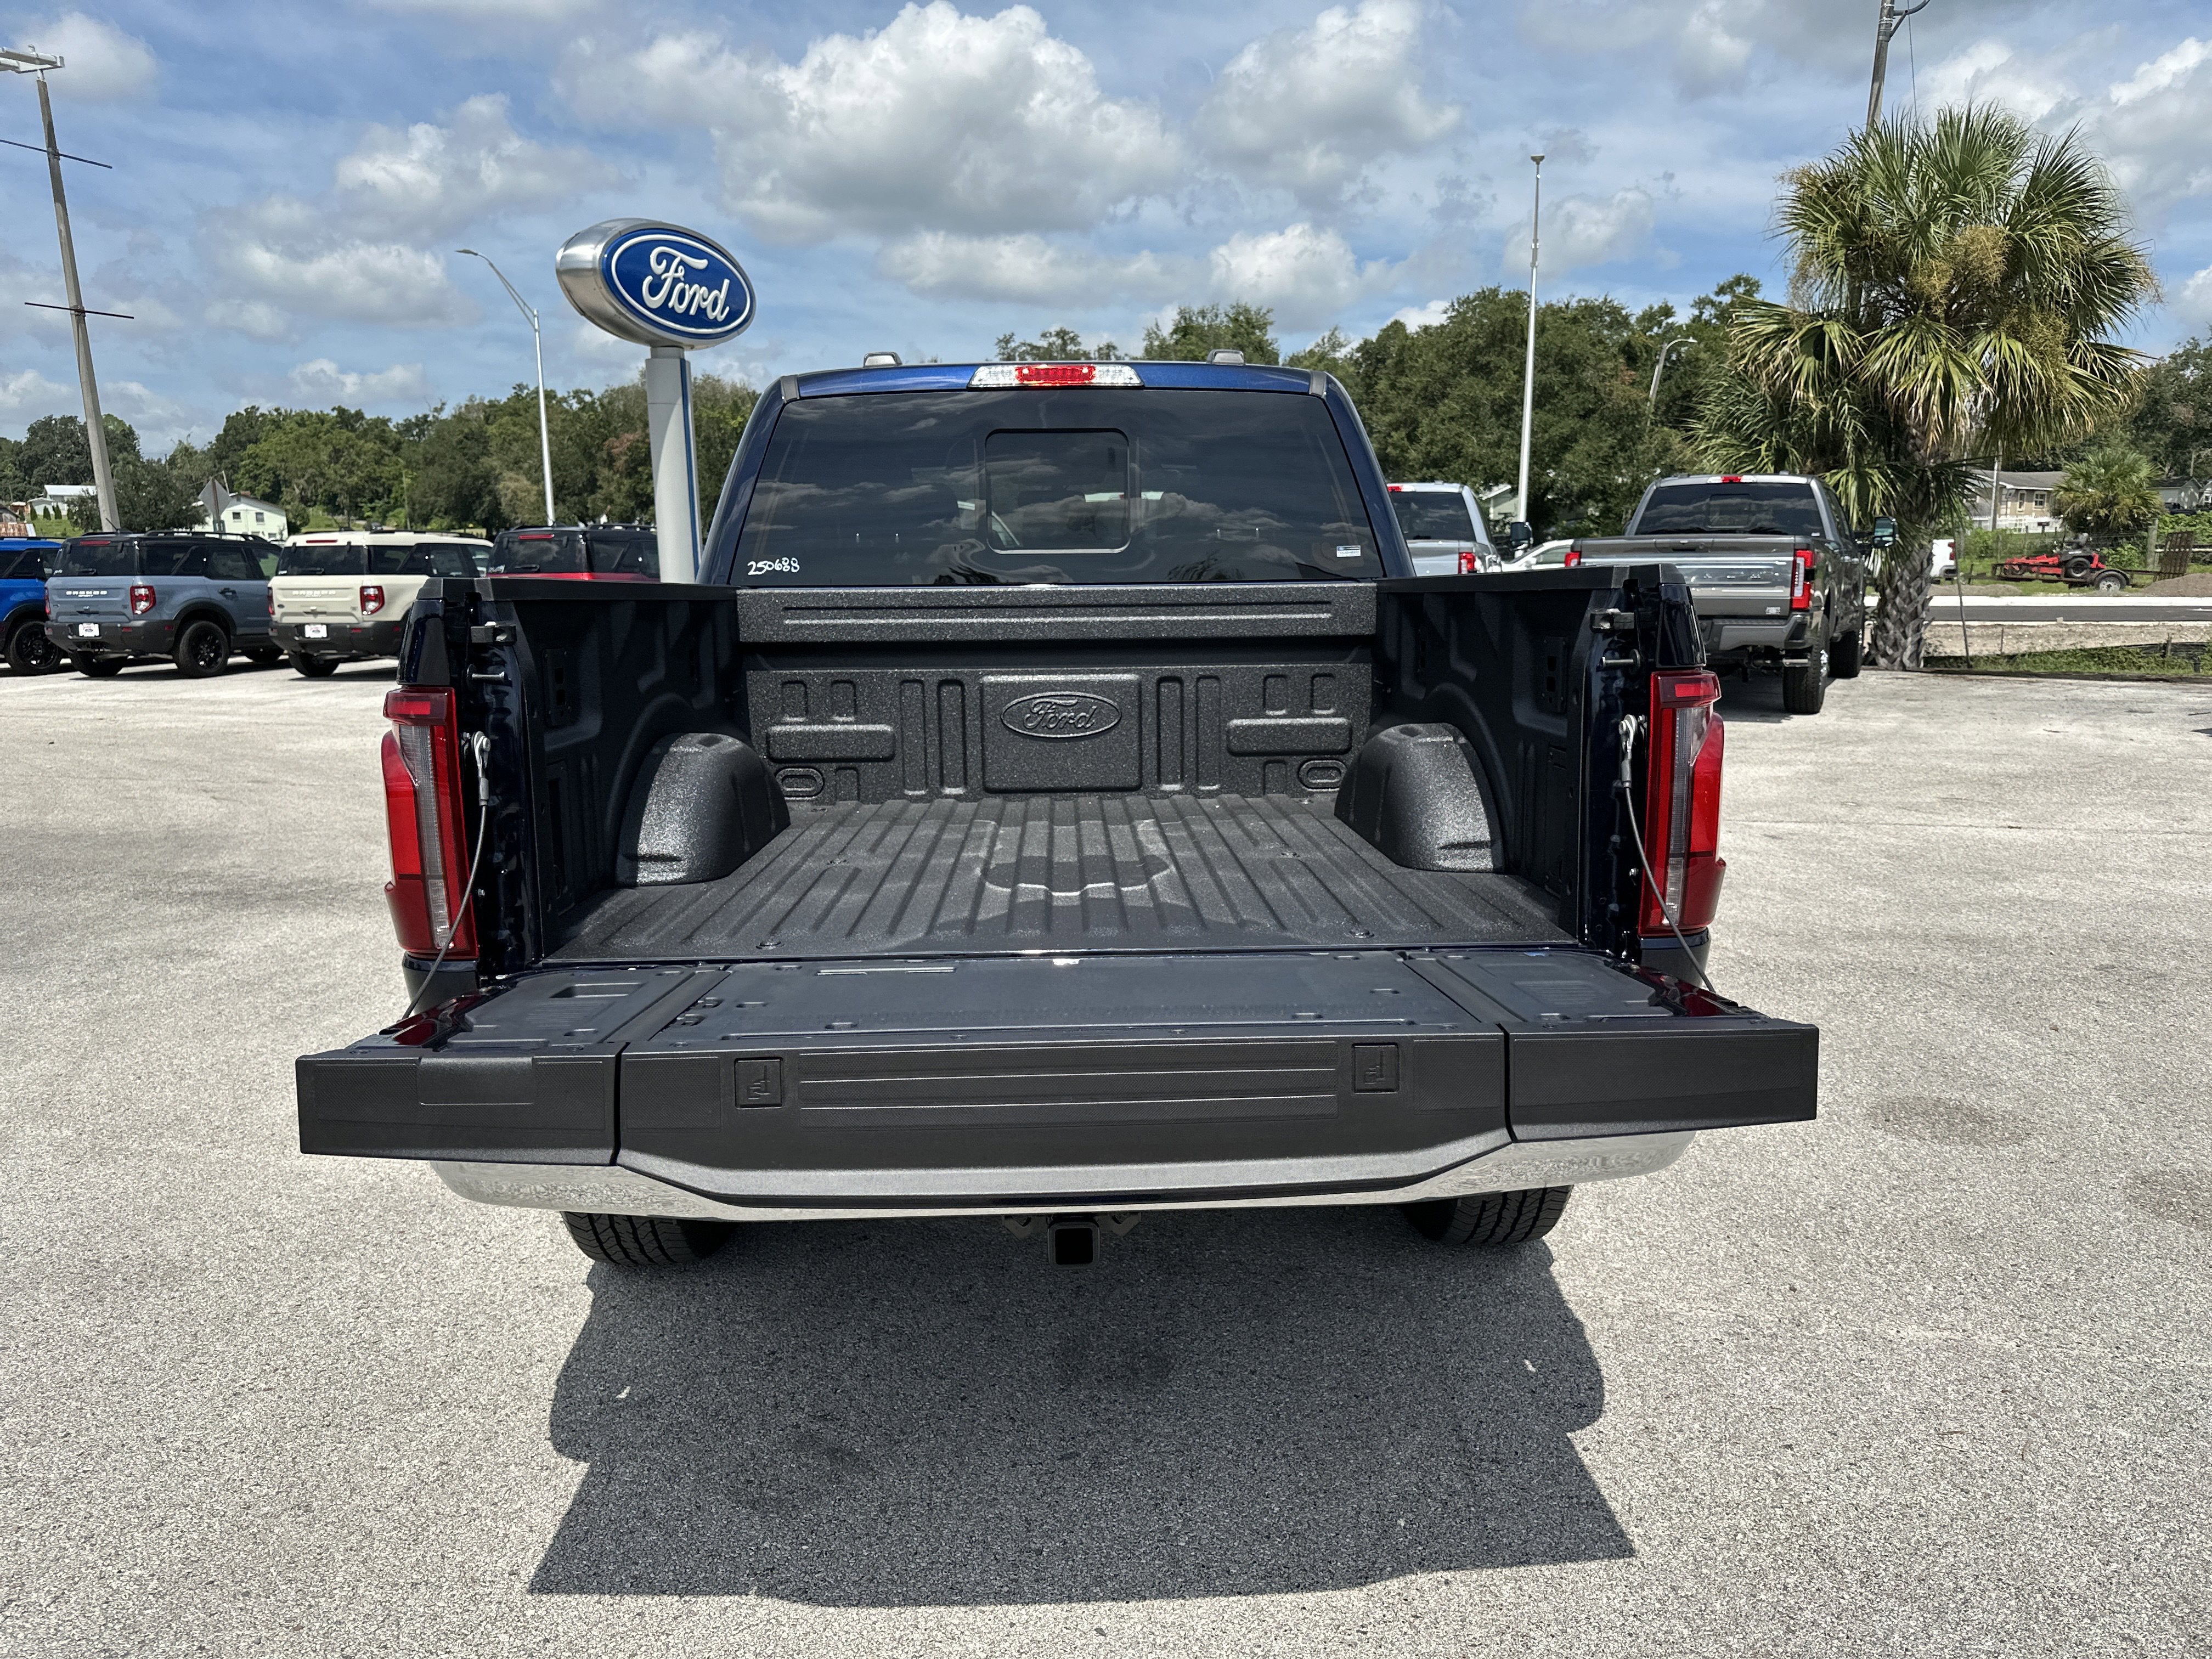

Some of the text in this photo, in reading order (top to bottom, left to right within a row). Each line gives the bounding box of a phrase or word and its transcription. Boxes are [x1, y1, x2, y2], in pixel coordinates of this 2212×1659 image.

[642, 246, 730, 323] Ford
[747, 557, 800, 575] 250688
[1023, 698, 1098, 730] Ford
